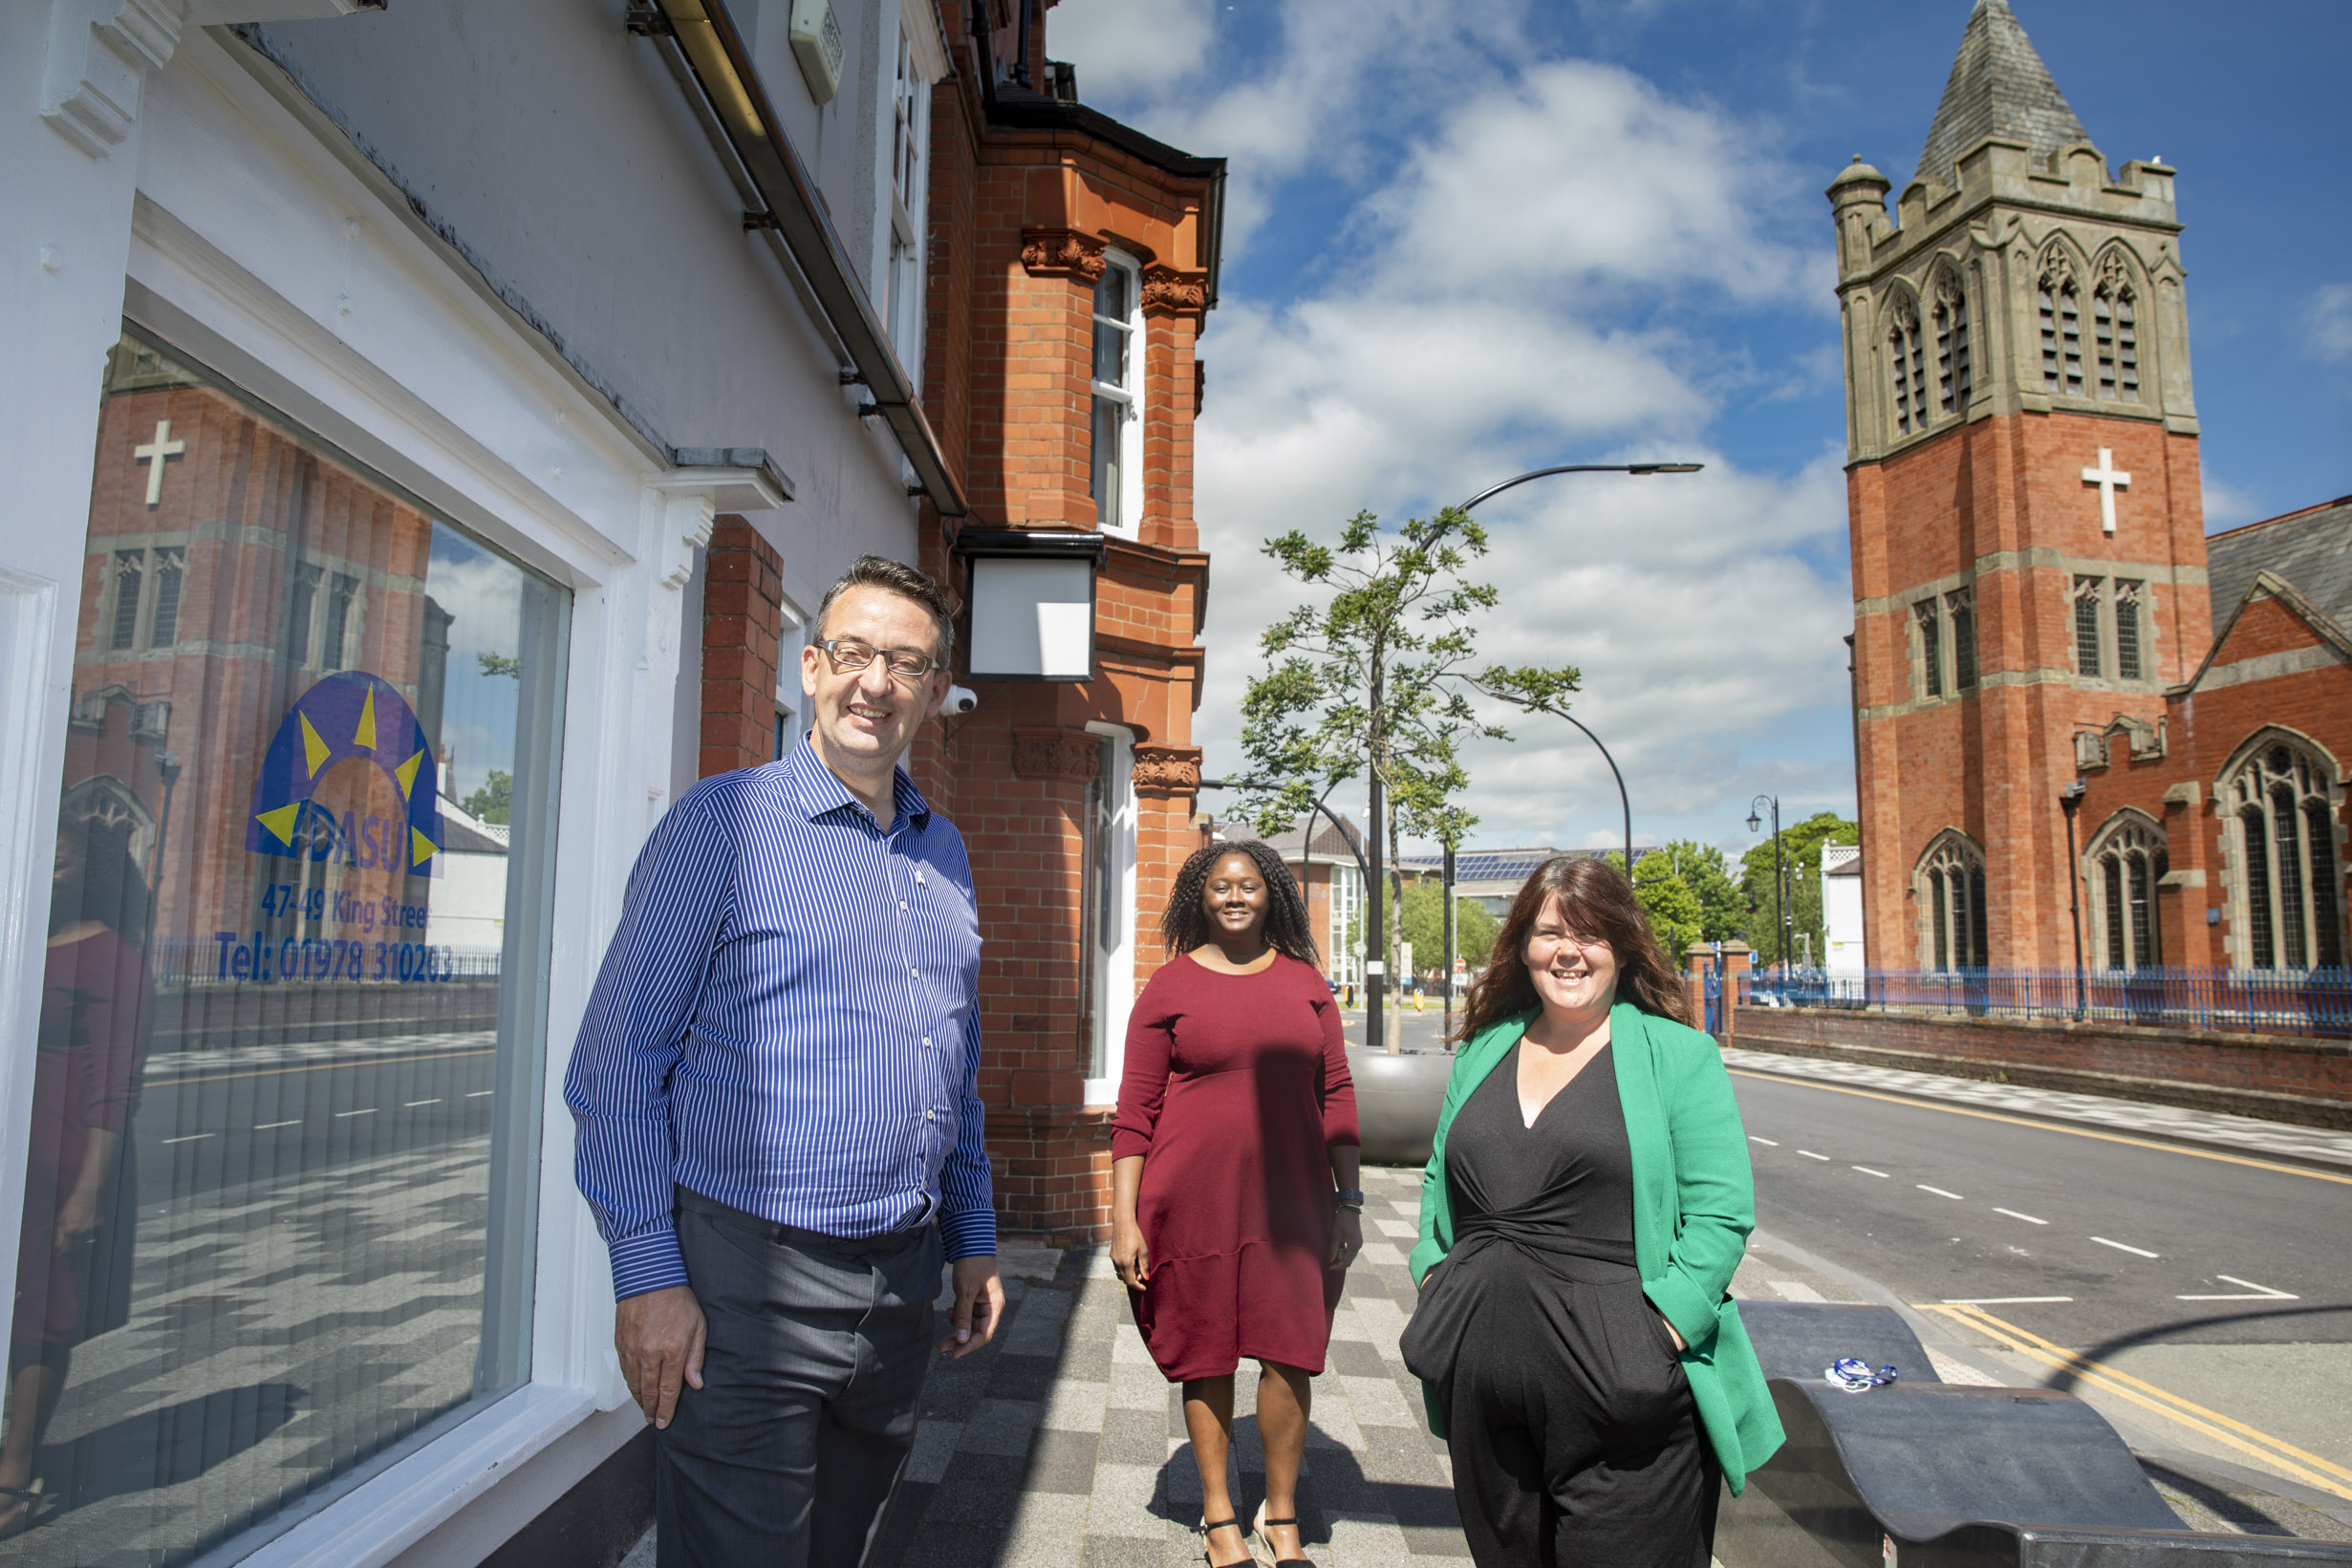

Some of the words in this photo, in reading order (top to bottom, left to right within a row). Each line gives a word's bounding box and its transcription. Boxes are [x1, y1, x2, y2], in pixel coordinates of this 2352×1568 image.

[308, 808, 404, 873] DASU
[261, 883, 327, 922] 47-49
[332, 890, 376, 934] King
[380, 894, 432, 929] Street
[214, 931, 271, 981] Tel:
[280, 935, 363, 982] 01978
[373, 941, 453, 982] 310203
